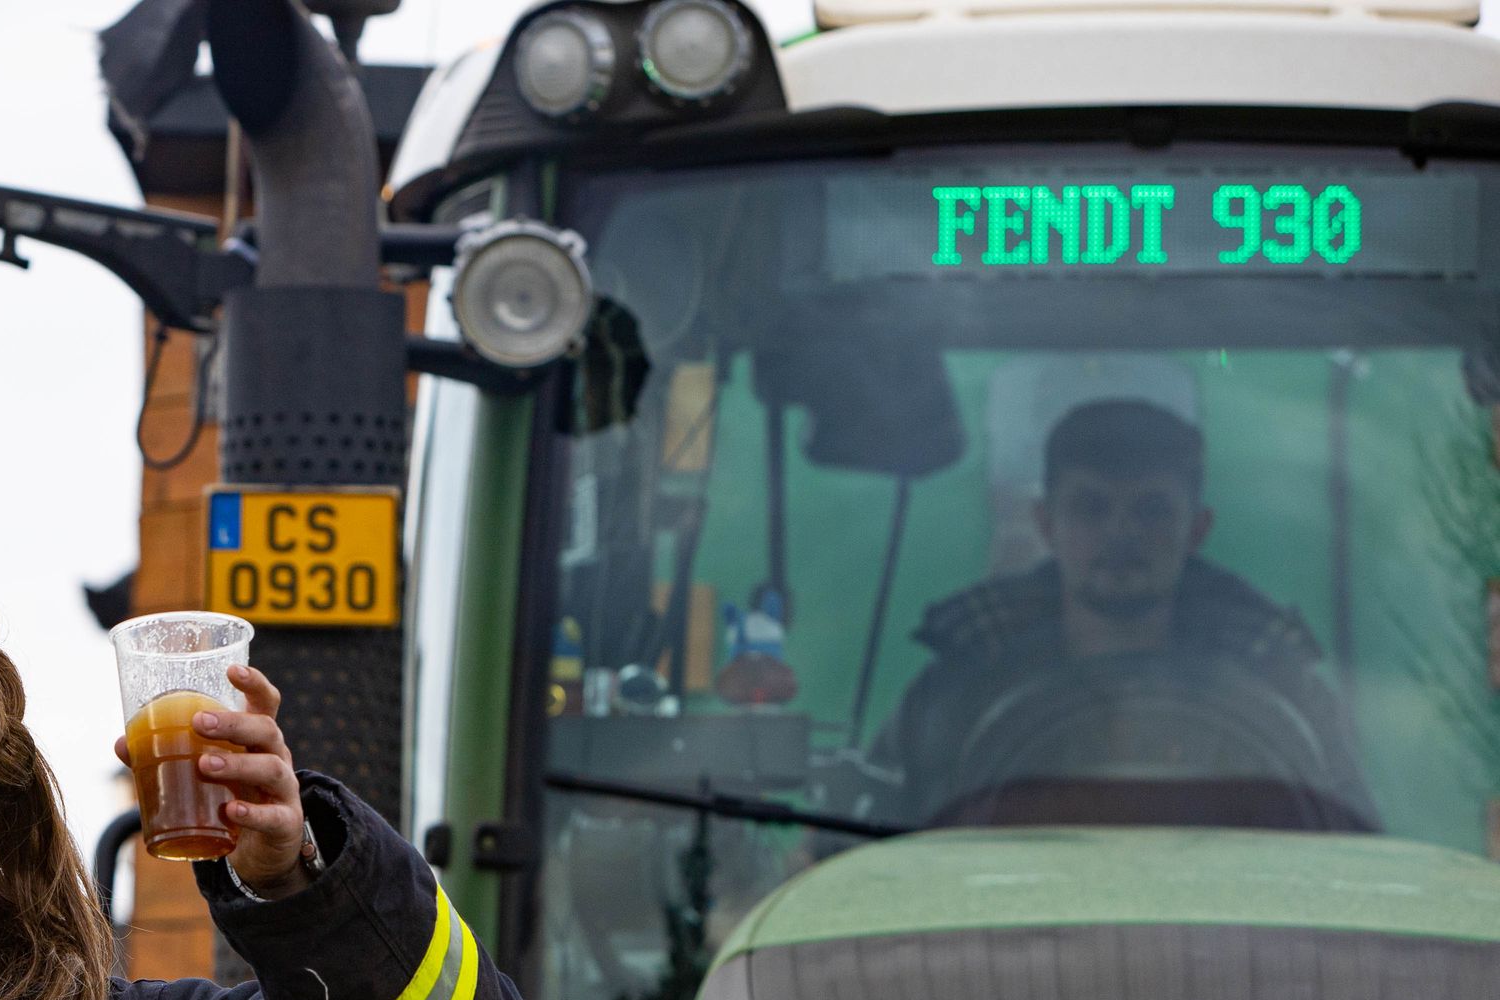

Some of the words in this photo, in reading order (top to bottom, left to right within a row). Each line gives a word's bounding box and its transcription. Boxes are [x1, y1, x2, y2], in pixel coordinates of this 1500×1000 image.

[932, 185, 1175, 265] FENDT
[1212, 184, 1362, 264] 930
[267, 503, 338, 554] CS
[229, 562, 377, 612] 0930
